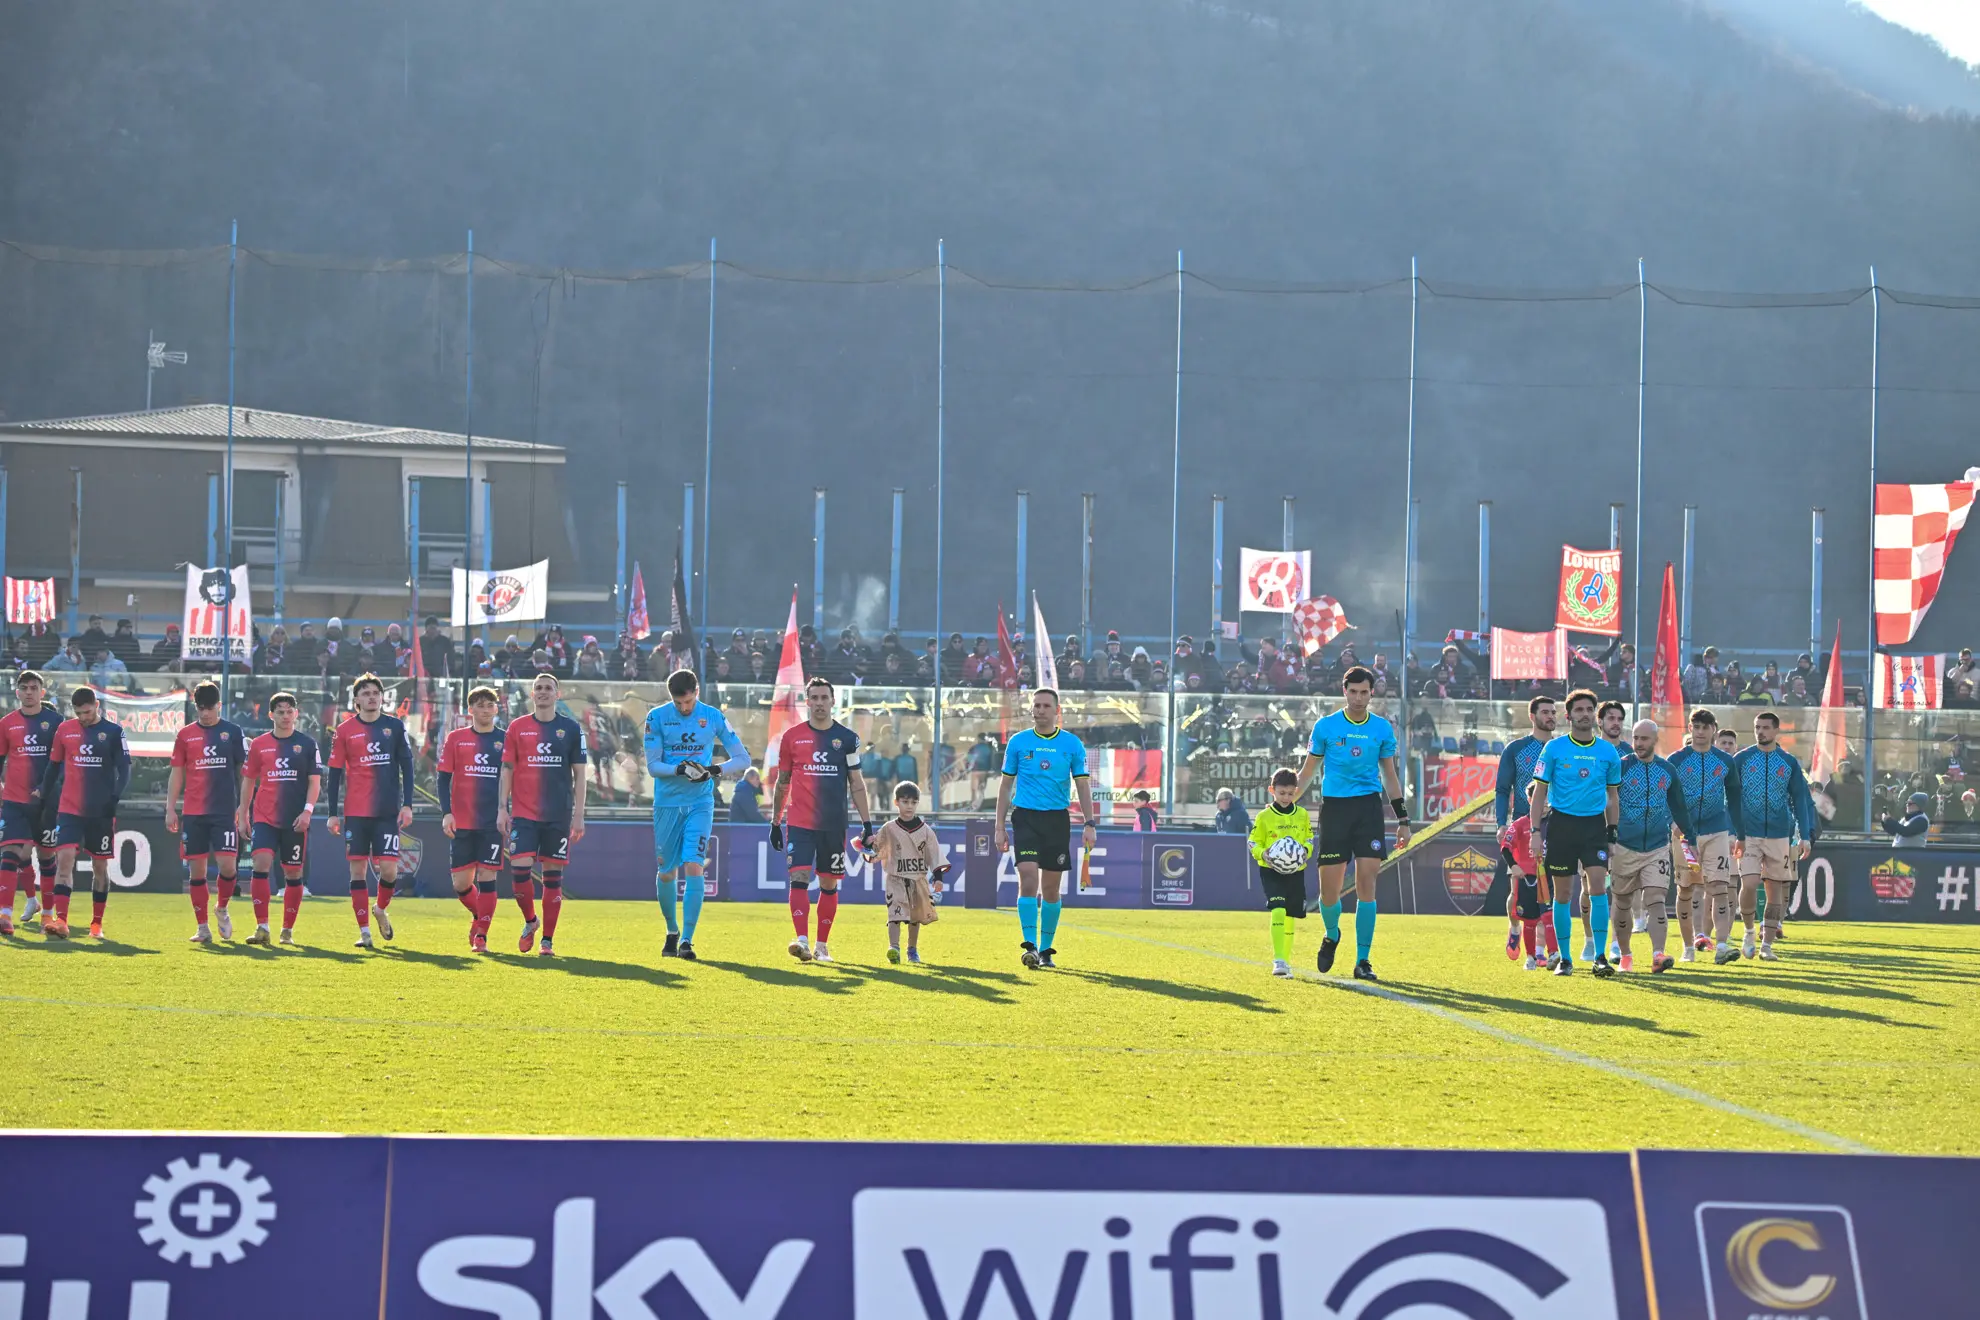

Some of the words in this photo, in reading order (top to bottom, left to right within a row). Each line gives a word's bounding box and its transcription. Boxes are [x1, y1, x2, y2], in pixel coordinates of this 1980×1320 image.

[1563, 551, 1621, 574] LONIGO
[188, 647, 245, 658] VENDRME
[195, 757, 227, 766] CAMOZZI
[360, 753, 391, 763] CAMOZZI
[527, 755, 562, 763] CAMOZZI
[267, 769, 298, 777] CAMOZZI
[464, 765, 498, 774] CAMOZZI
[803, 764, 838, 772] CAMOZZI
[101, 835, 110, 851] 8
[224, 831, 235, 847] 11
[383, 833, 400, 851] 70
[558, 837, 568, 854] 2
[292, 844, 301, 861] 3
[490, 843, 500, 861] 7
[831, 852, 846, 869] 23
[897, 858, 929, 873] DIESEL
[1161, 879, 1178, 887] SERIE
[417, 1197, 816, 1320] sky
[902, 1216, 1283, 1320] wifi
